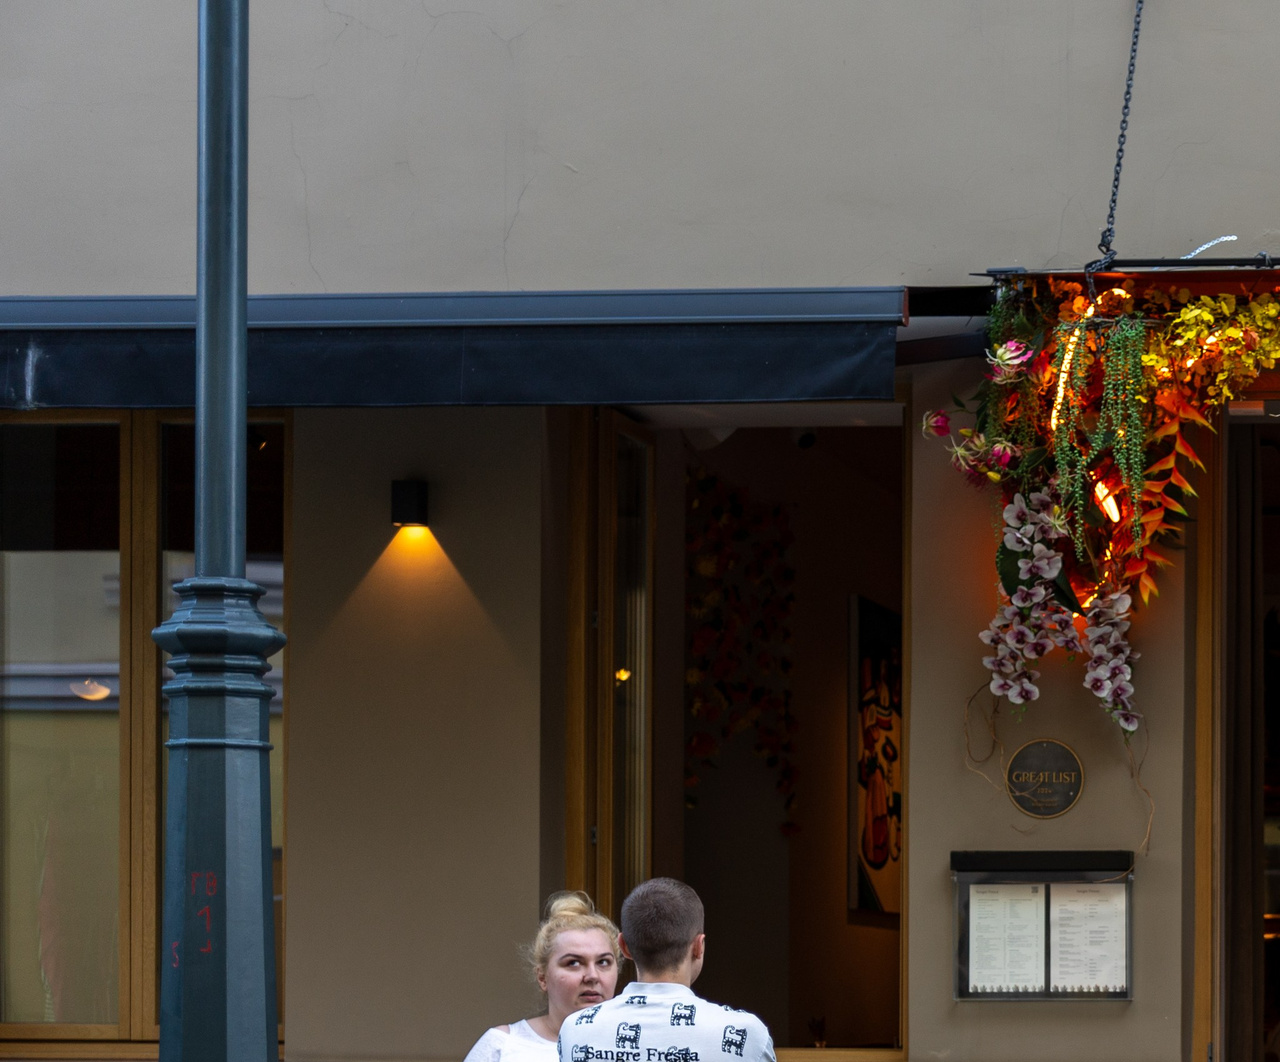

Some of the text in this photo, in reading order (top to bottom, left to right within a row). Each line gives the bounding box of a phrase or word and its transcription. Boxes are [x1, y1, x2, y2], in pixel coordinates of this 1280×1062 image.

[1012, 771, 1078, 783] GREAT LIST
[587, 1047, 640, 1062] Sangre
